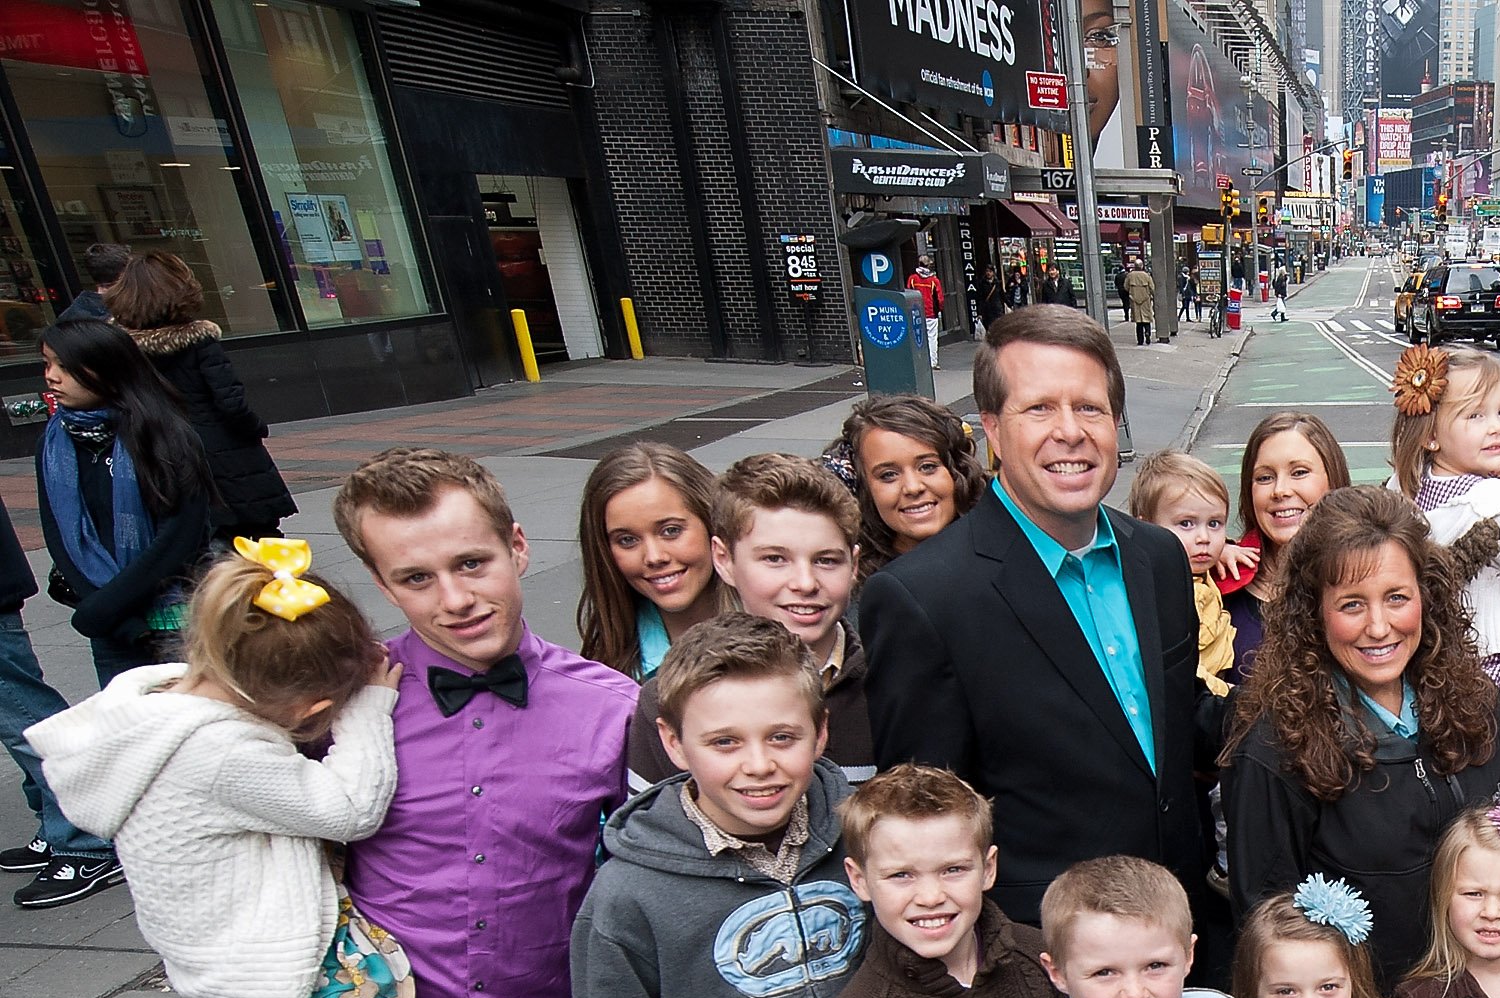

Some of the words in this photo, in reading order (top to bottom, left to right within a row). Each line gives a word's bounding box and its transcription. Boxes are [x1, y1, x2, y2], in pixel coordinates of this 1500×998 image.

[921, 68, 939, 85] Official
[1030, 76, 1038, 85] NO
[1039, 77, 1064, 87] STOPPING
[1036, 86, 1059, 96] ANYTIME
[1380, 124, 1394, 133] THIS
[1395, 124, 1410, 133] NEW
[925, 177, 946, 187] CLUB
[786, 244, 815, 253] special
[960, 229, 977, 292] ROBATA
[871, 254, 889, 282] P
[879, 306, 898, 314] MUNI
[880, 315, 904, 323] METER
[878, 325, 892, 333] PAY
